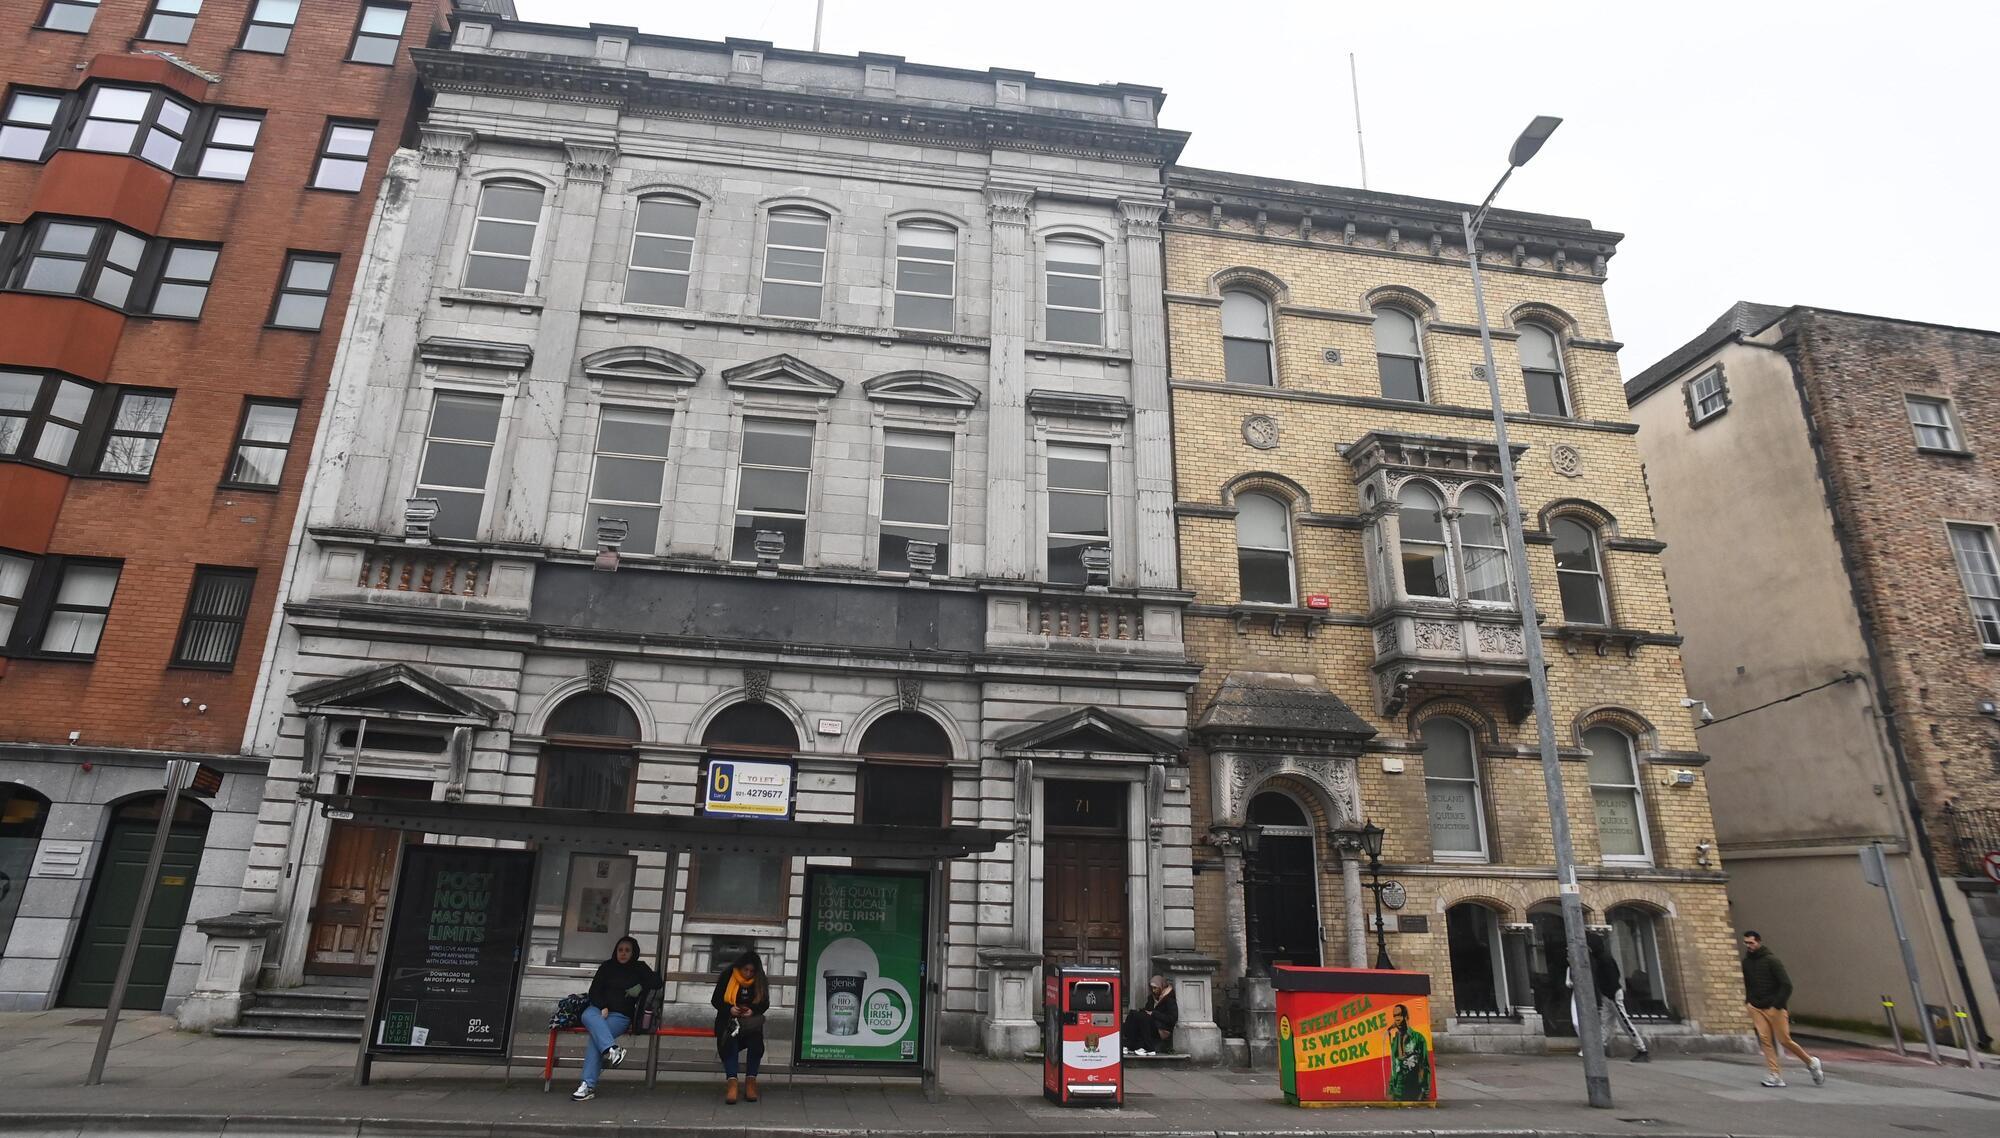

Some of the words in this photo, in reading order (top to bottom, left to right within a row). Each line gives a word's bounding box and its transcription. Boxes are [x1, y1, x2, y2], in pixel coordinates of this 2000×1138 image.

[714, 767, 729, 793] b
[1075, 799, 1089, 813] 71
[437, 871, 495, 891] POST
[819, 886, 846, 897] LOVE
[848, 887, 898, 898] QUALITY?
[433, 889, 492, 910] NOW
[818, 897, 846, 908] LOVE
[431, 910, 462, 924] HAS
[463, 911, 488, 926] NO
[818, 909, 850, 920] LOVE
[852, 911, 886, 921] IRISH
[817, 921, 856, 933] FOOD.
[428, 925, 486, 943] LIMITS
[832, 977, 857, 990] glenisk
[870, 1003, 889, 1011] LOVE
[870, 1010, 893, 1019] IRISH
[1300, 1009, 1339, 1035] EVERY
[1342, 995, 1373, 1019] FELA
[469, 1018, 482, 1026] an
[869, 1018, 892, 1026] FOOD
[467, 1024, 490, 1034] post
[1302, 1037, 1317, 1051] IS
[1318, 1012, 1388, 1049] WELCOME
[1308, 1053, 1326, 1069] IN
[1329, 1040, 1370, 1065] CORK
